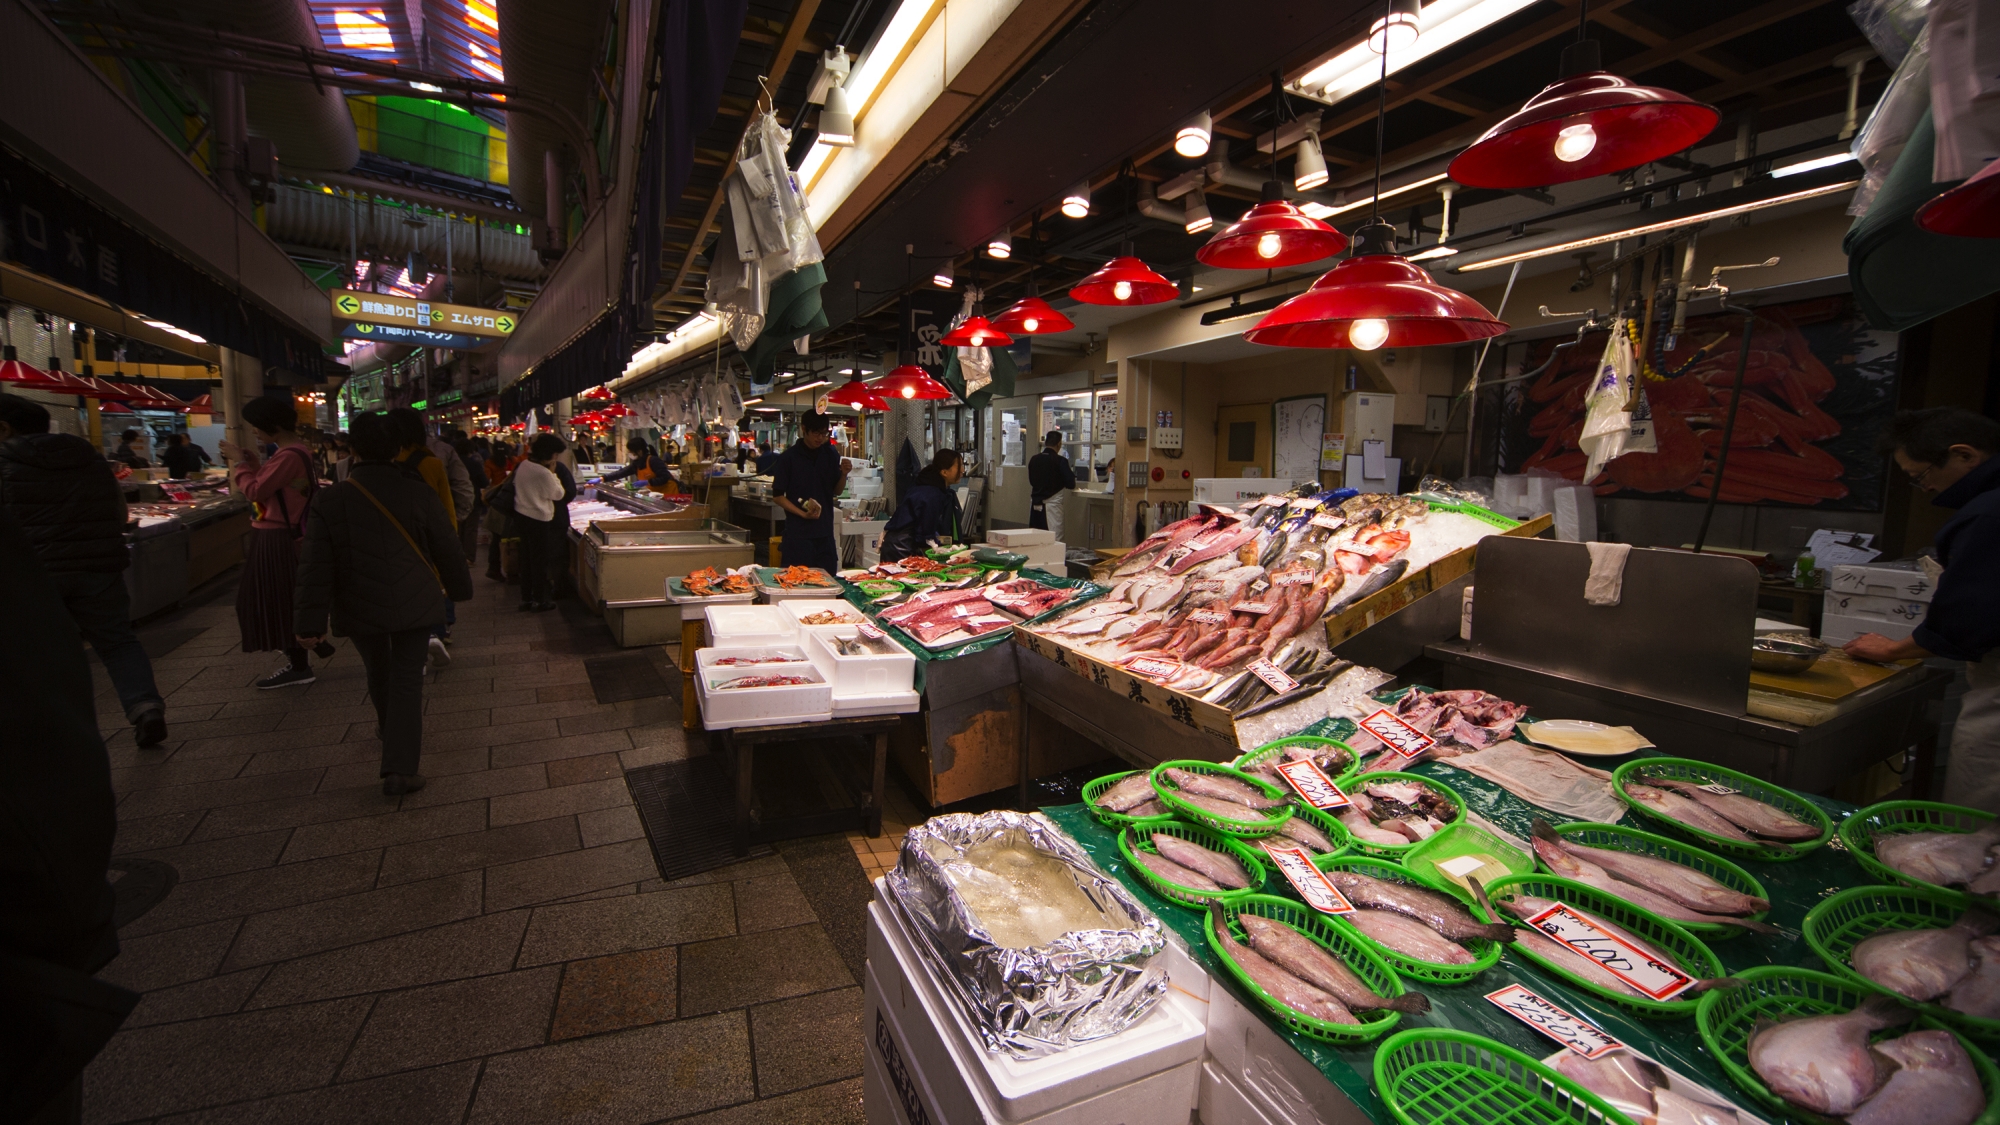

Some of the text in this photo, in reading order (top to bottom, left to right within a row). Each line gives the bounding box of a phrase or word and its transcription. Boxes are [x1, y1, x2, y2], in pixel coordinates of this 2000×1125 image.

[361, 300, 416, 319] 鮮魚通り口
[451, 313, 495, 328] エムザ口
[1567, 938, 1634, 971] 600
